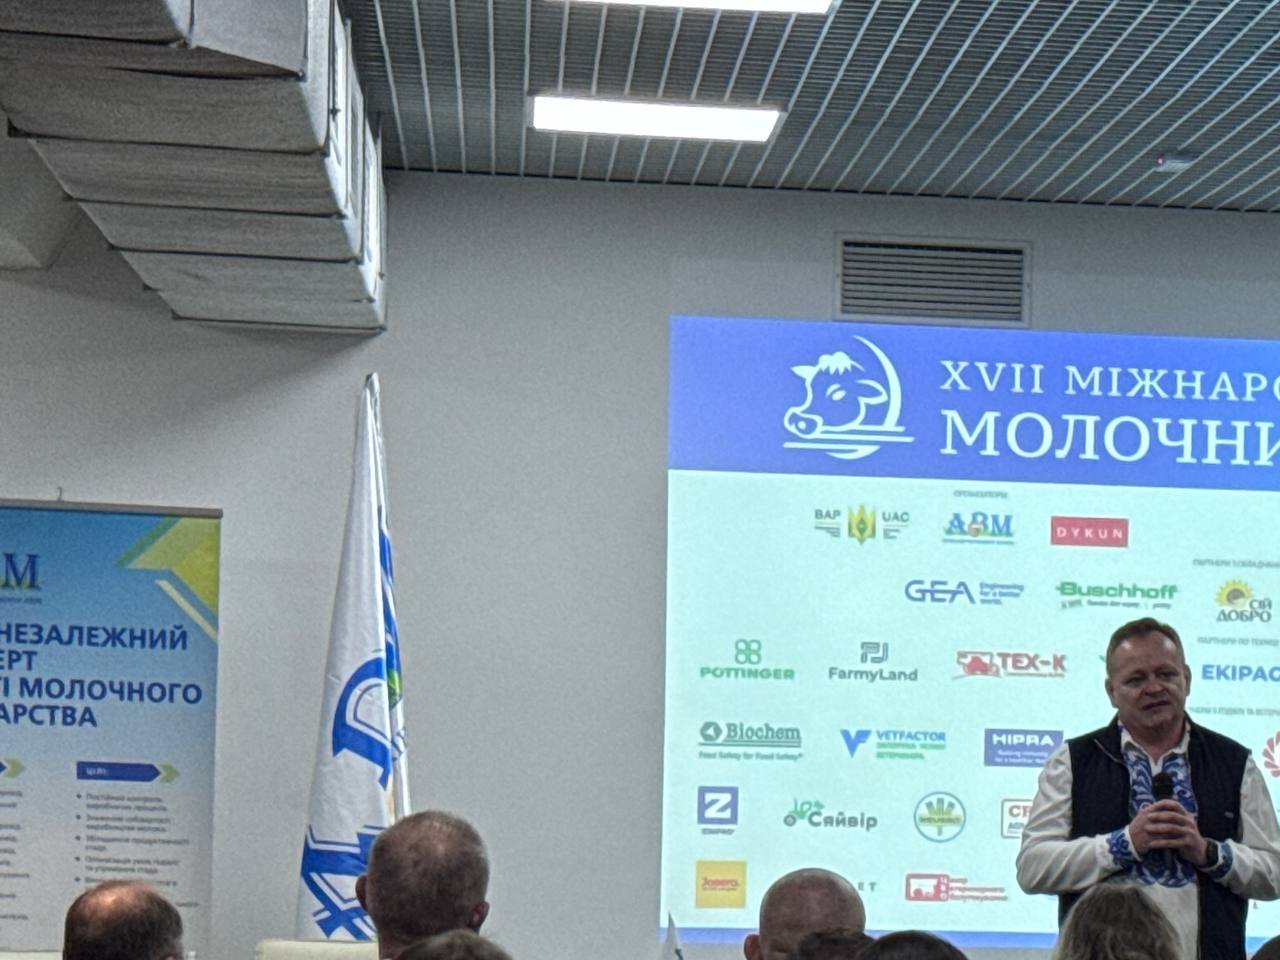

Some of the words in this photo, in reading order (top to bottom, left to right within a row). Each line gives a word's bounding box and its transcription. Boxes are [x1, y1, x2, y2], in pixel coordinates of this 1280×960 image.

[939, 360, 1045, 394] XVII
[1056, 526, 1123, 539] DYKUN
[905, 580, 976, 604] GEA
[1057, 581, 1178, 600] Buschhoff
[1216, 608, 1272, 623] ДОБРО
[828, 666, 918, 682] FarmyLand
[19, 676, 203, 705] МОЛОЧНОГО
[726, 722, 800, 740] Biochem
[876, 731, 946, 741] VETFACTOR
[992, 733, 1055, 746] HIPRA
